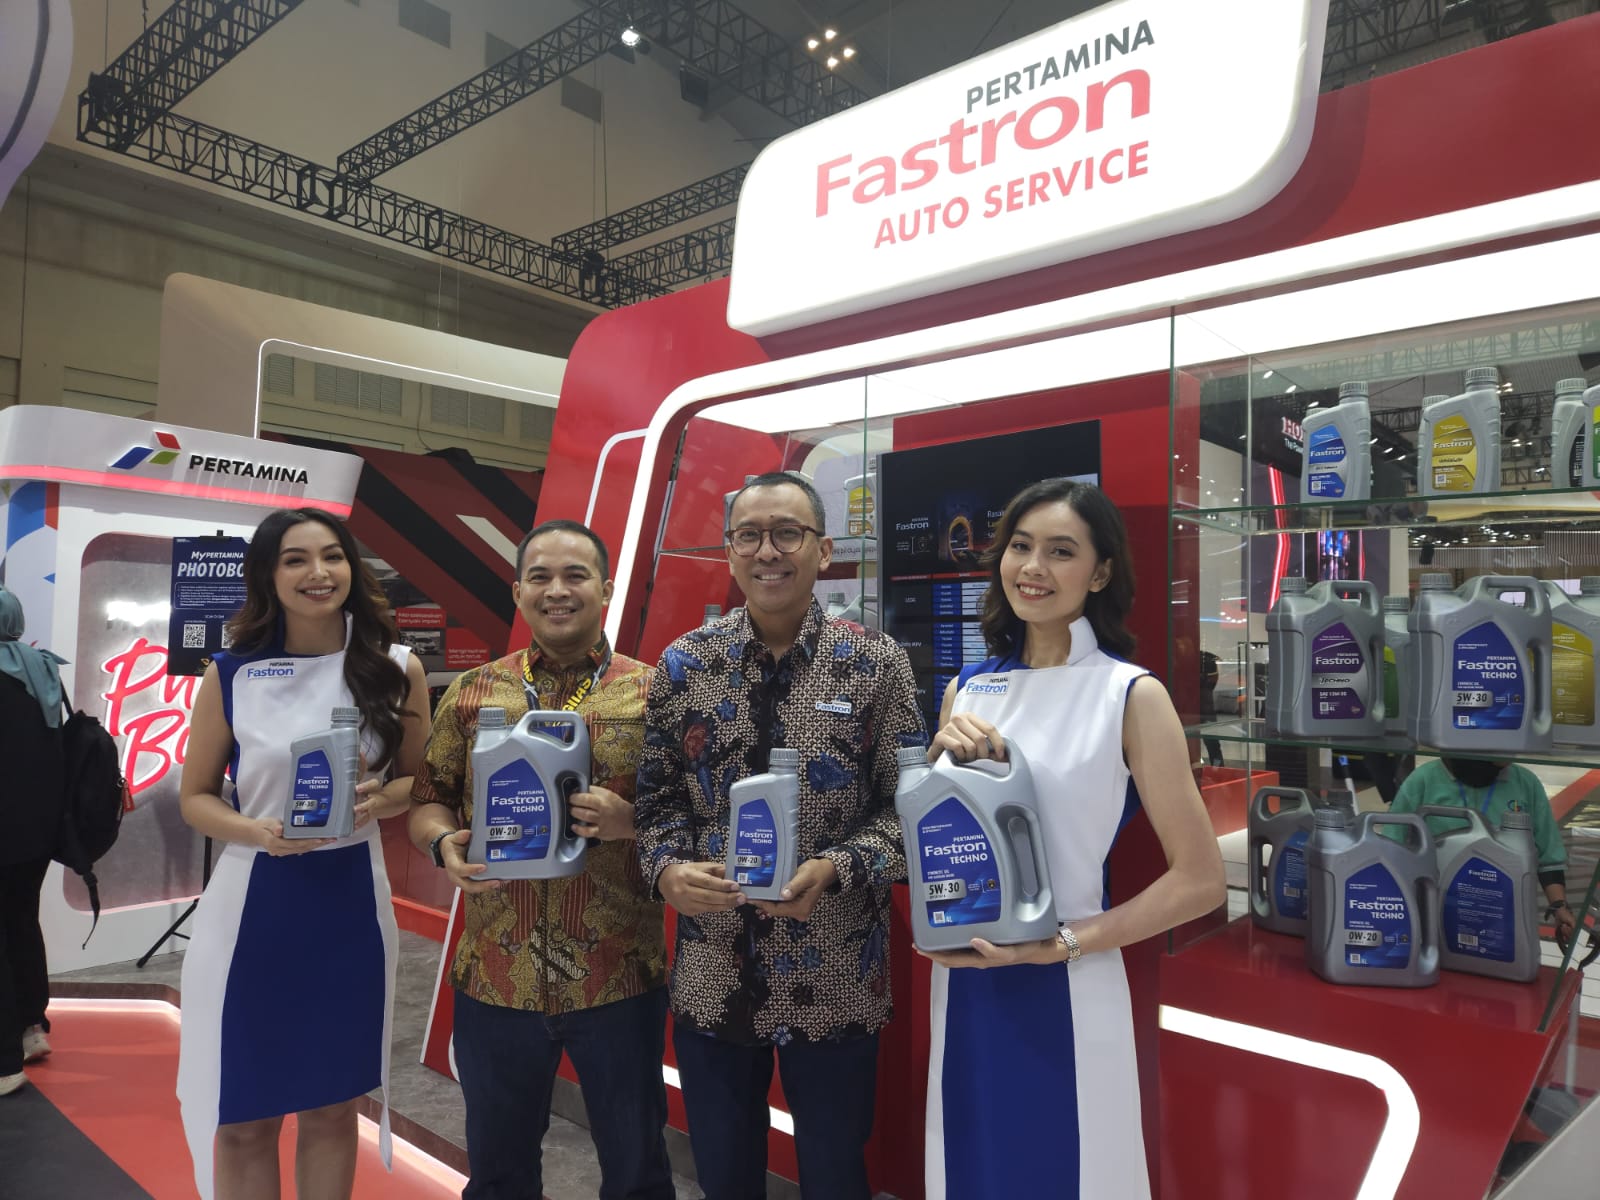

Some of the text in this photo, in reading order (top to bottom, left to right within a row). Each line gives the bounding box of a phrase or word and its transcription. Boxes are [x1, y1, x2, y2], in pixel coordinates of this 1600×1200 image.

[966, 19, 1155, 114] PERTAMINA
[815, 69, 1151, 217] Fastron
[874, 141, 1149, 248] AUTO SERVICE
[189, 454, 309, 484] PERTAMINA
[896, 522, 929, 531] Fastron
[1315, 657, 1359, 665] Fastron
[1458, 660, 1517, 670] Fastron
[247, 667, 294, 679] Fastron
[1481, 671, 1517, 679] TECHNO
[966, 682, 1008, 693] Fastron
[1456, 693, 1487, 702] 5W-30
[816, 702, 850, 712] Fastron
[491, 796, 545, 806] Fastron
[512, 805, 545, 813] TECHNO
[489, 826, 518, 836] 0W-20
[739, 830, 773, 839] Fastron
[953, 834, 985, 843] PERTAMINA
[924, 842, 987, 857] Fastron
[737, 856, 758, 864] 0W-20
[949, 853, 988, 865] TECHNO
[929, 882, 960, 895] 5W-30
[1349, 899, 1404, 911] Fastron
[1371, 911, 1405, 920] TECHNO
[1348, 931, 1378, 941] 0W-20
